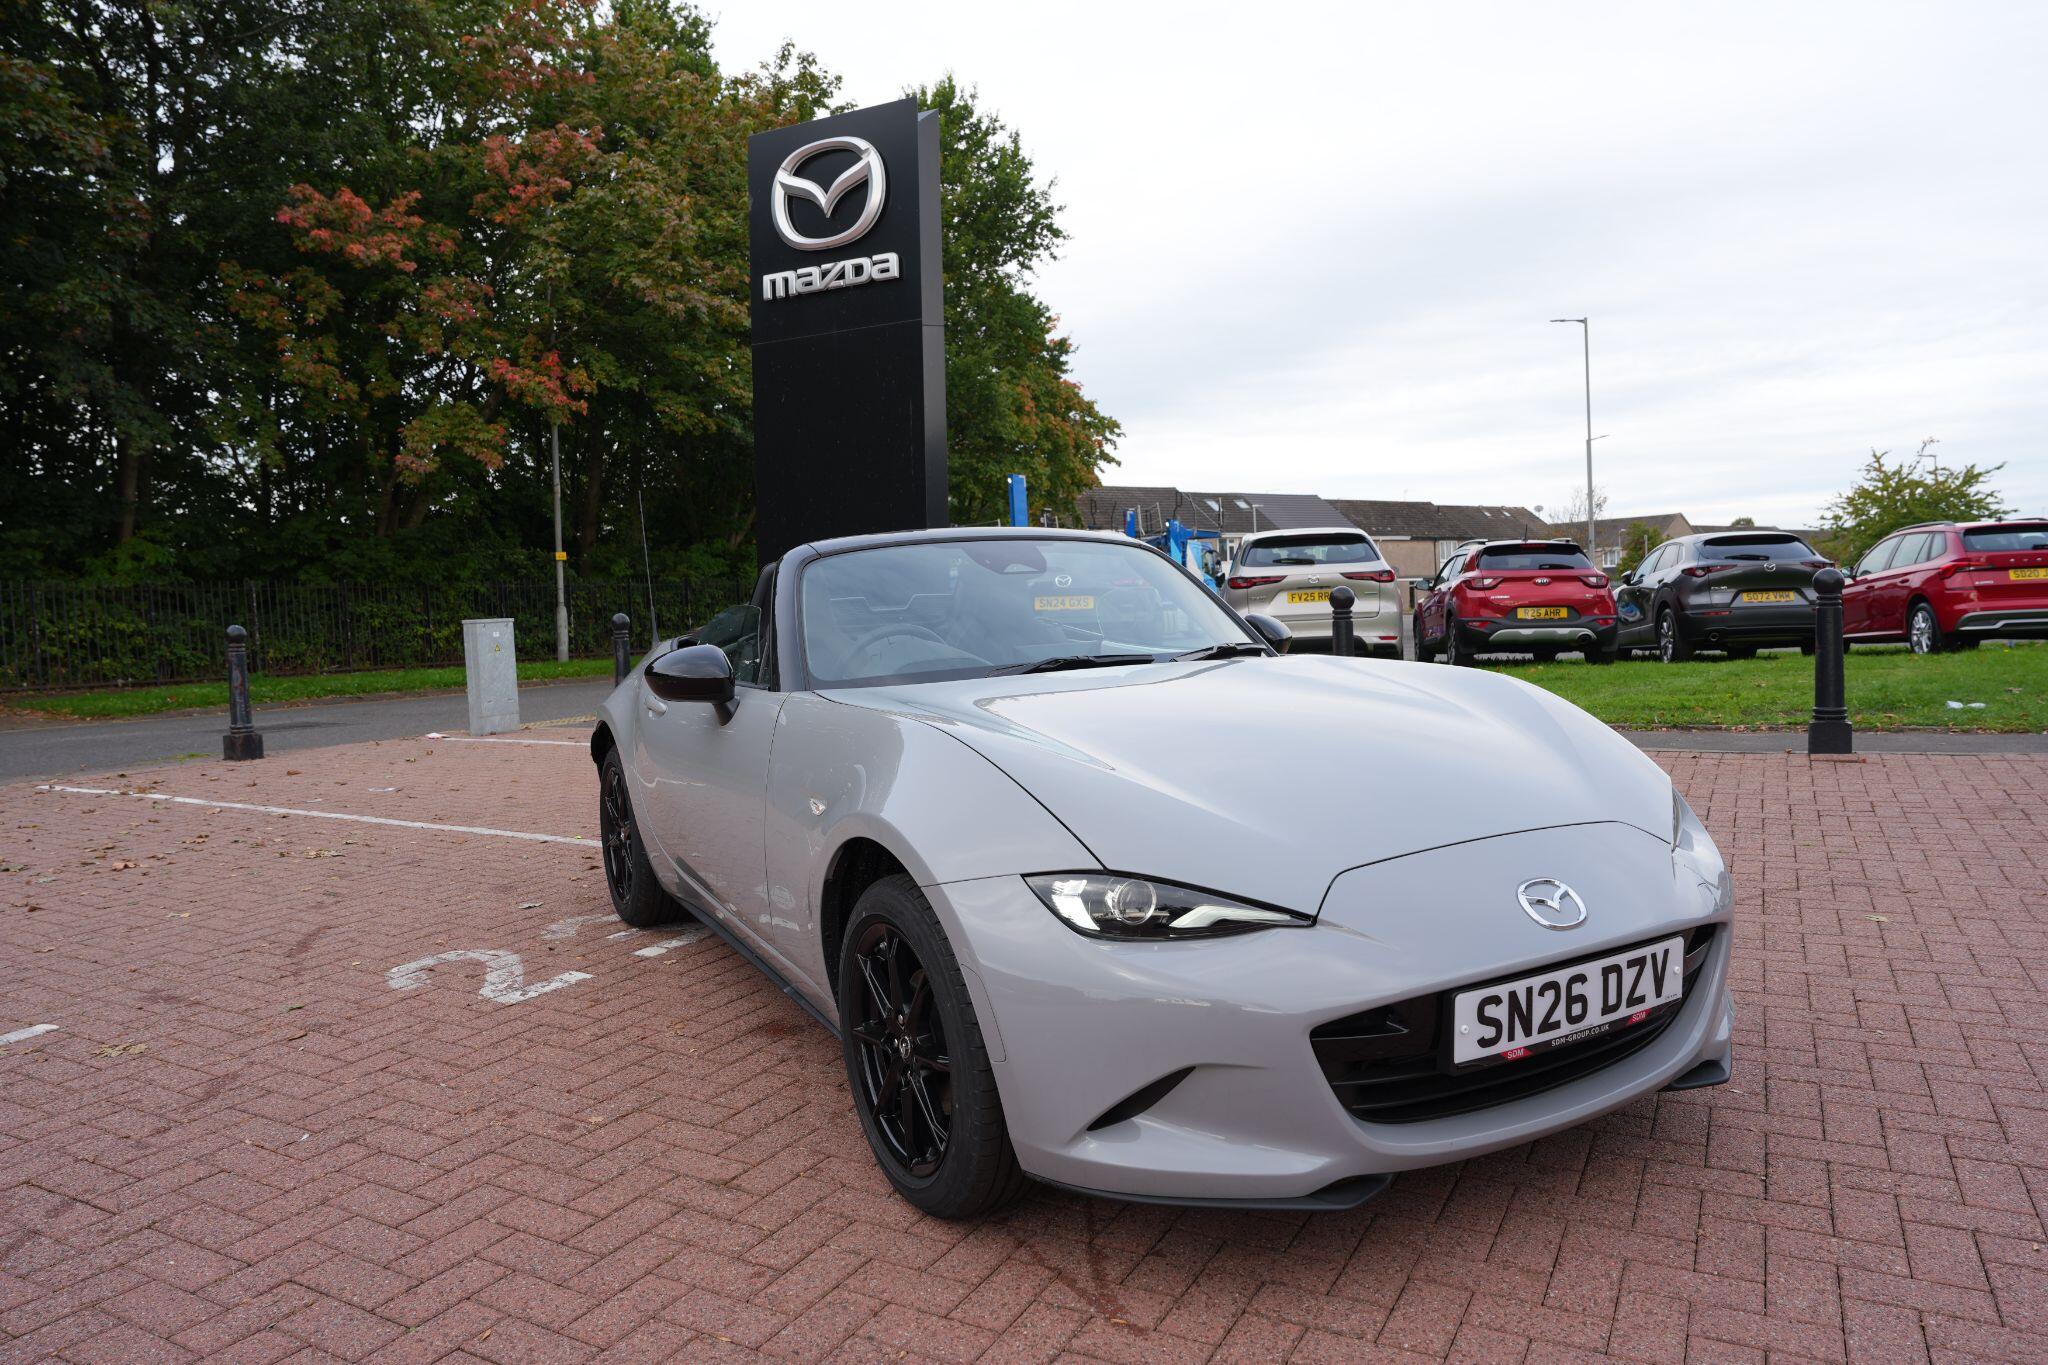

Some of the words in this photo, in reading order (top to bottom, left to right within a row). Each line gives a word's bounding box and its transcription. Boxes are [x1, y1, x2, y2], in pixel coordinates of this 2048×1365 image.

[1291, 591, 1315, 602] FV25
[1544, 608, 1561, 617] AHR
[1476, 973, 1588, 1048] SN26
[1601, 949, 1669, 1016] DZV
[1632, 1011, 1646, 1022] SDM
[1551, 1023, 1610, 1047] SDM-GROUP.CO.UK
[1507, 1049, 1524, 1059] SDM
